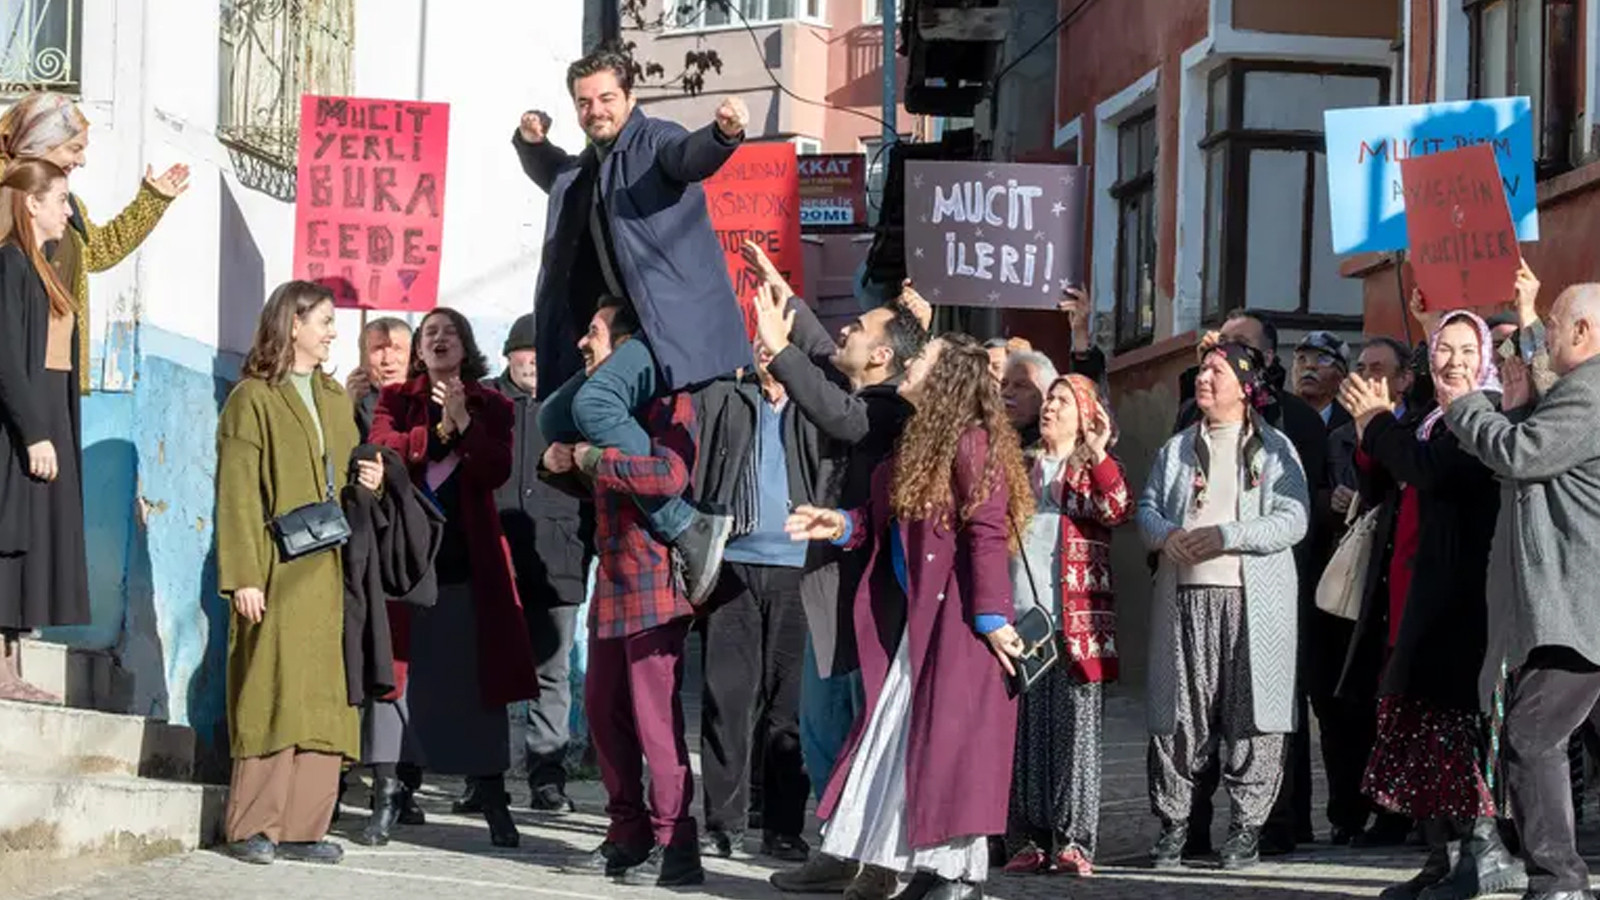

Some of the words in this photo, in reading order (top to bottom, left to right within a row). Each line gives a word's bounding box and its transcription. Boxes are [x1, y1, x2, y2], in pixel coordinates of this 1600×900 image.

[309, 165, 439, 217] BURA
[932, 179, 1043, 231] MUCİT
[946, 232, 1054, 293] İLERİ!
